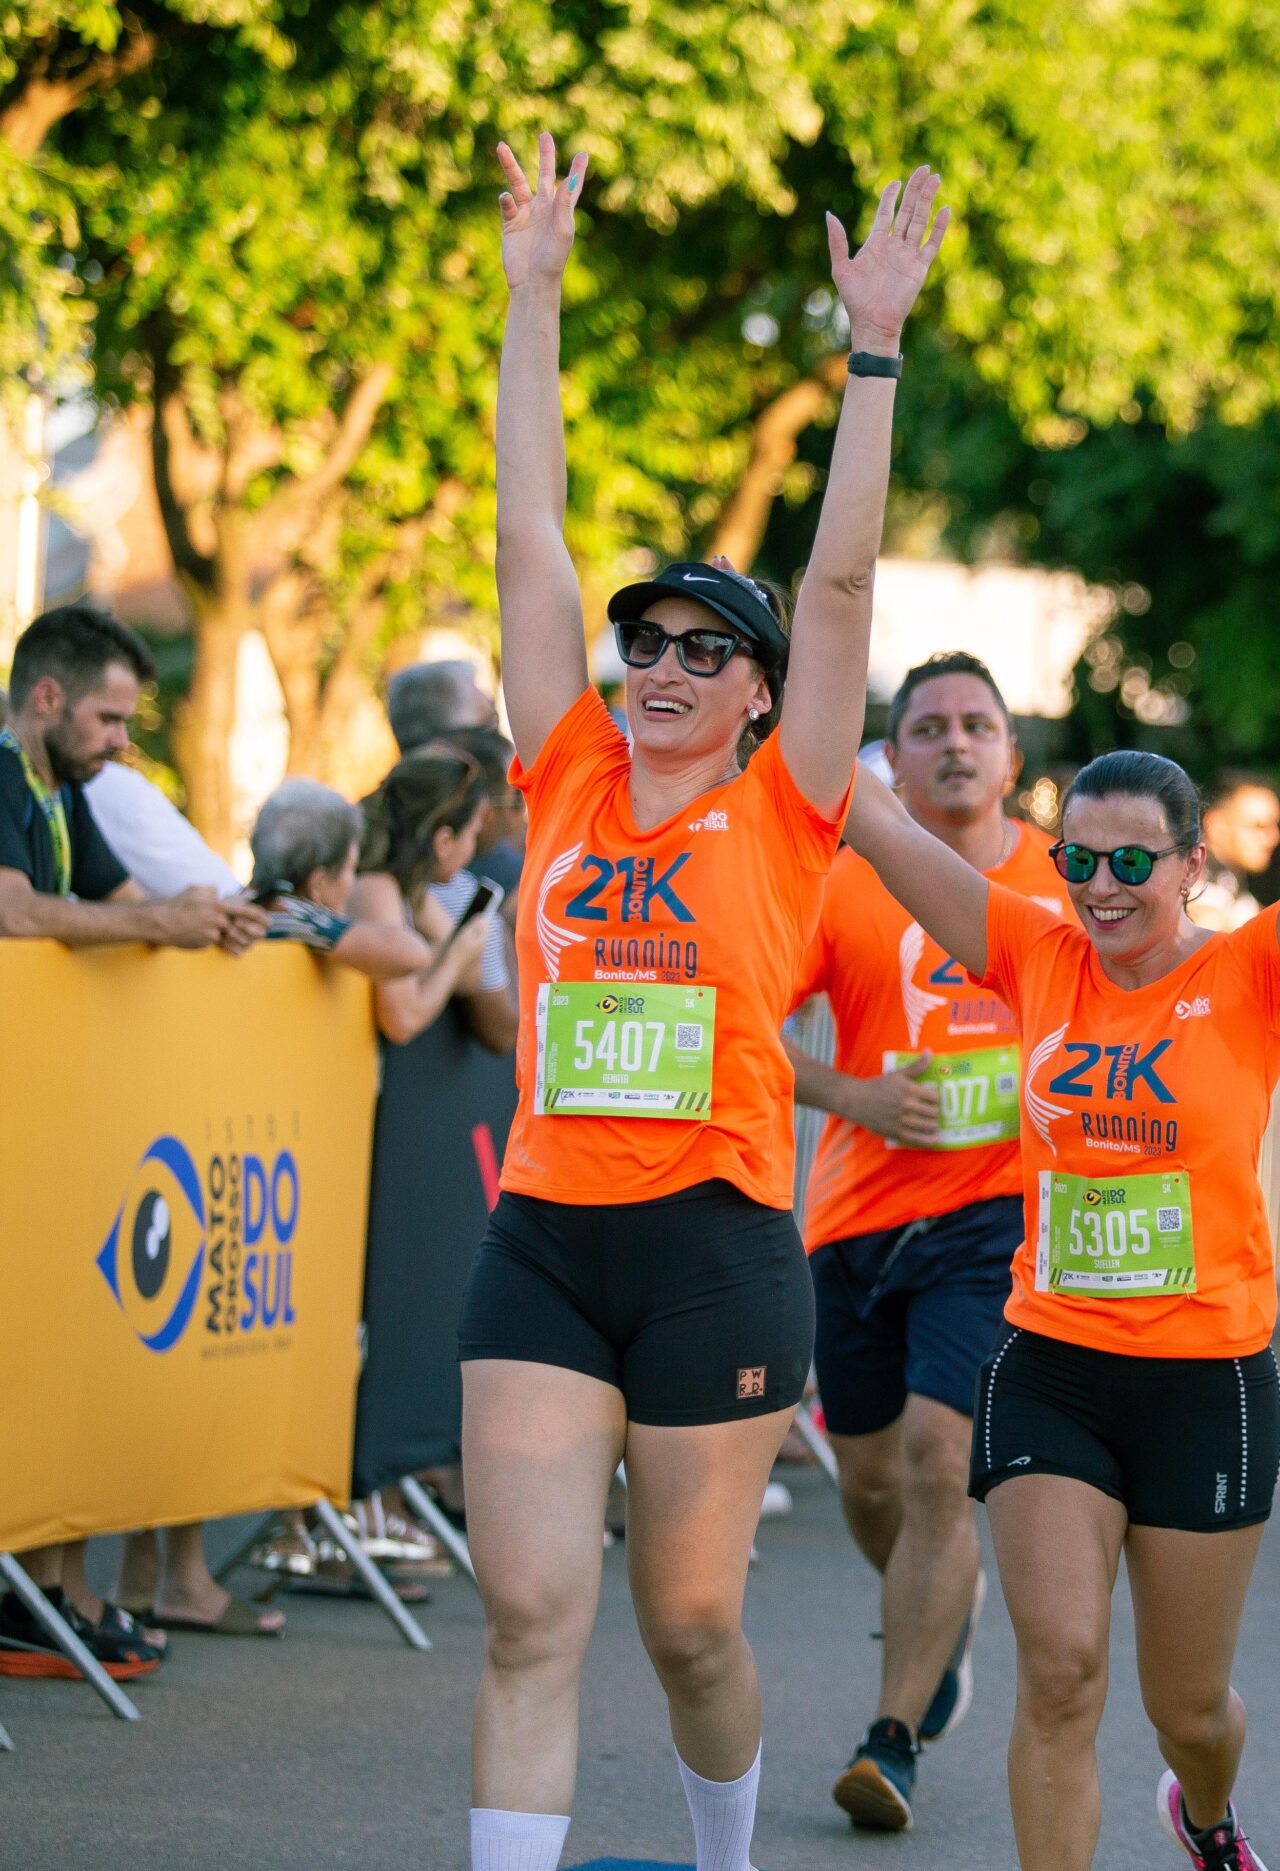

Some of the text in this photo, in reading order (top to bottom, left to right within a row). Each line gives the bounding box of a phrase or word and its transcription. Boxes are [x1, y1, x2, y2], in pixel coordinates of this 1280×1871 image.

[565, 852, 697, 922] 21K
[628, 856, 650, 922] BONITO
[594, 969, 657, 980] Bonito/MS
[595, 933, 697, 978] Running
[628, 997, 645, 1006] DO
[628, 1006, 645, 1014] SUL
[574, 1020, 666, 1073] 5407
[1048, 1039, 1178, 1104] 21K
[1112, 1045, 1135, 1099] BONITO
[923, 1076, 989, 1118] 077
[1081, 1111, 1178, 1152] Running
[1085, 1137, 1162, 1156] Bonito/MS 2023
[242, 1150, 300, 1246] DO
[1110, 1188, 1126, 1197] DO
[1110, 1196, 1126, 1204] SUL
[206, 1154, 224, 1334] MATO
[1069, 1208, 1150, 1257] 5305
[240, 1251, 296, 1332] SUL
[1214, 1471, 1228, 1514] SPRINT
